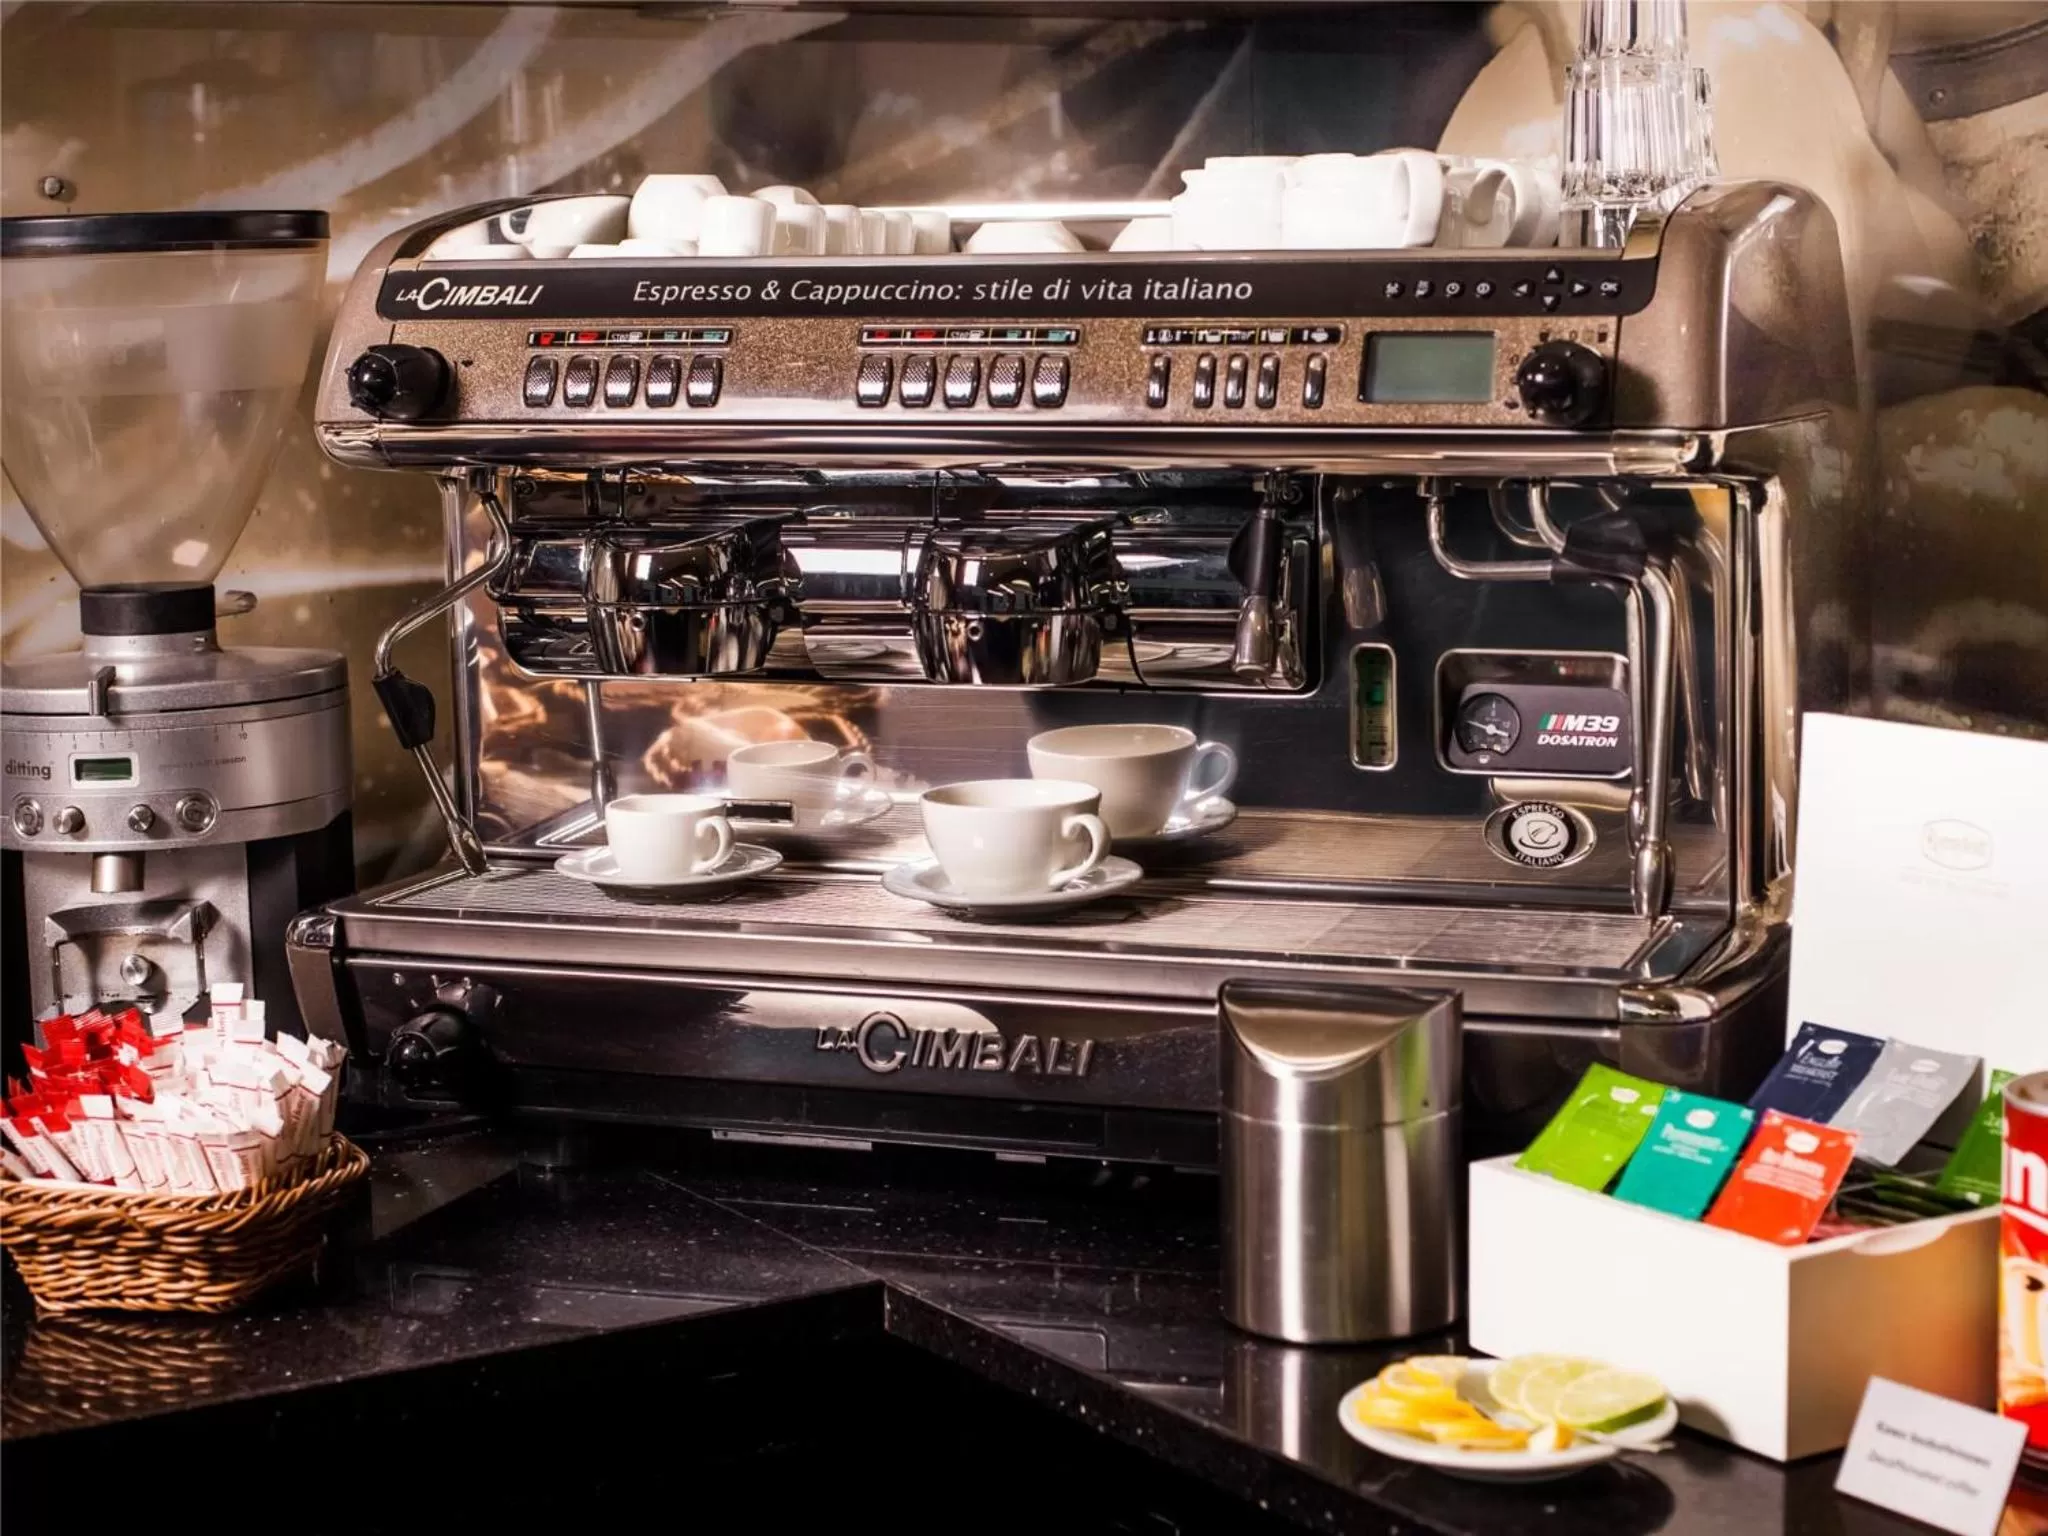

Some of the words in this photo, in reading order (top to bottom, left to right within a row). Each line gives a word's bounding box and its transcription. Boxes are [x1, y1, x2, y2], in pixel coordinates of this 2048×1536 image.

[396, 288, 419, 302] LA
[417, 277, 544, 311] CIMBALI
[632, 281, 752, 306] Espresso
[760, 279, 781, 301] &
[790, 279, 963, 306] Cappuccino:
[972, 278, 1033, 301] stile
[1043, 278, 1072, 300] di
[1081, 278, 1133, 300] vita
[1144, 277, 1253, 300] italiano
[1600, 281, 1618, 292] OK
[1562, 714, 1620, 733] M39
[1537, 733, 1618, 748] DOSATRON
[4, 758, 51, 781] ditting
[1512, 804, 1565, 819] ESPRESSO
[1515, 851, 1565, 866] ITALIANO
[856, 1010, 1097, 1077] CIMBALI
